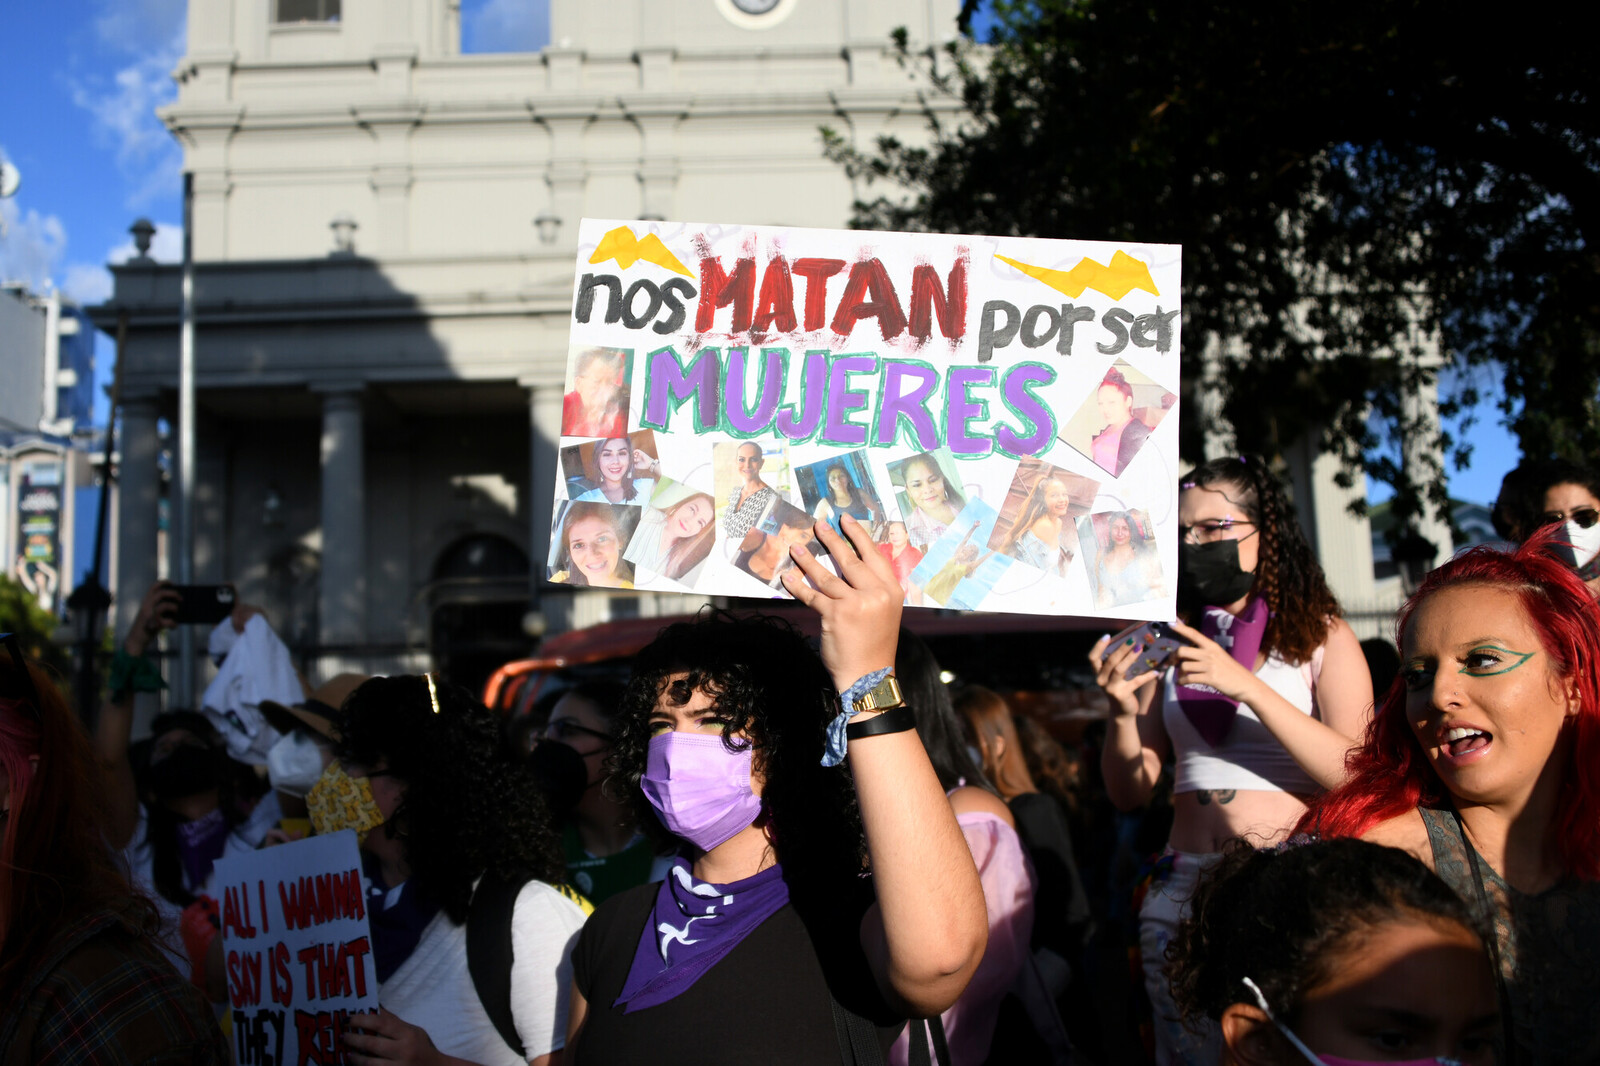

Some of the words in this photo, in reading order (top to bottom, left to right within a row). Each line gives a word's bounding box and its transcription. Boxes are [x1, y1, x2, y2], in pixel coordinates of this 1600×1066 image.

[575, 273, 698, 335] nos
[694, 244, 970, 345] MATAN
[977, 300, 1096, 363] por
[639, 346, 1058, 460] MUJERES
[223, 881, 257, 939] ALL
[258, 880, 269, 934] I
[278, 868, 366, 931] WANNA
[227, 949, 262, 1009] SAY
[268, 941, 294, 1008] IS
[297, 935, 371, 1001] THAT
[232, 1008, 286, 1065] THEY
